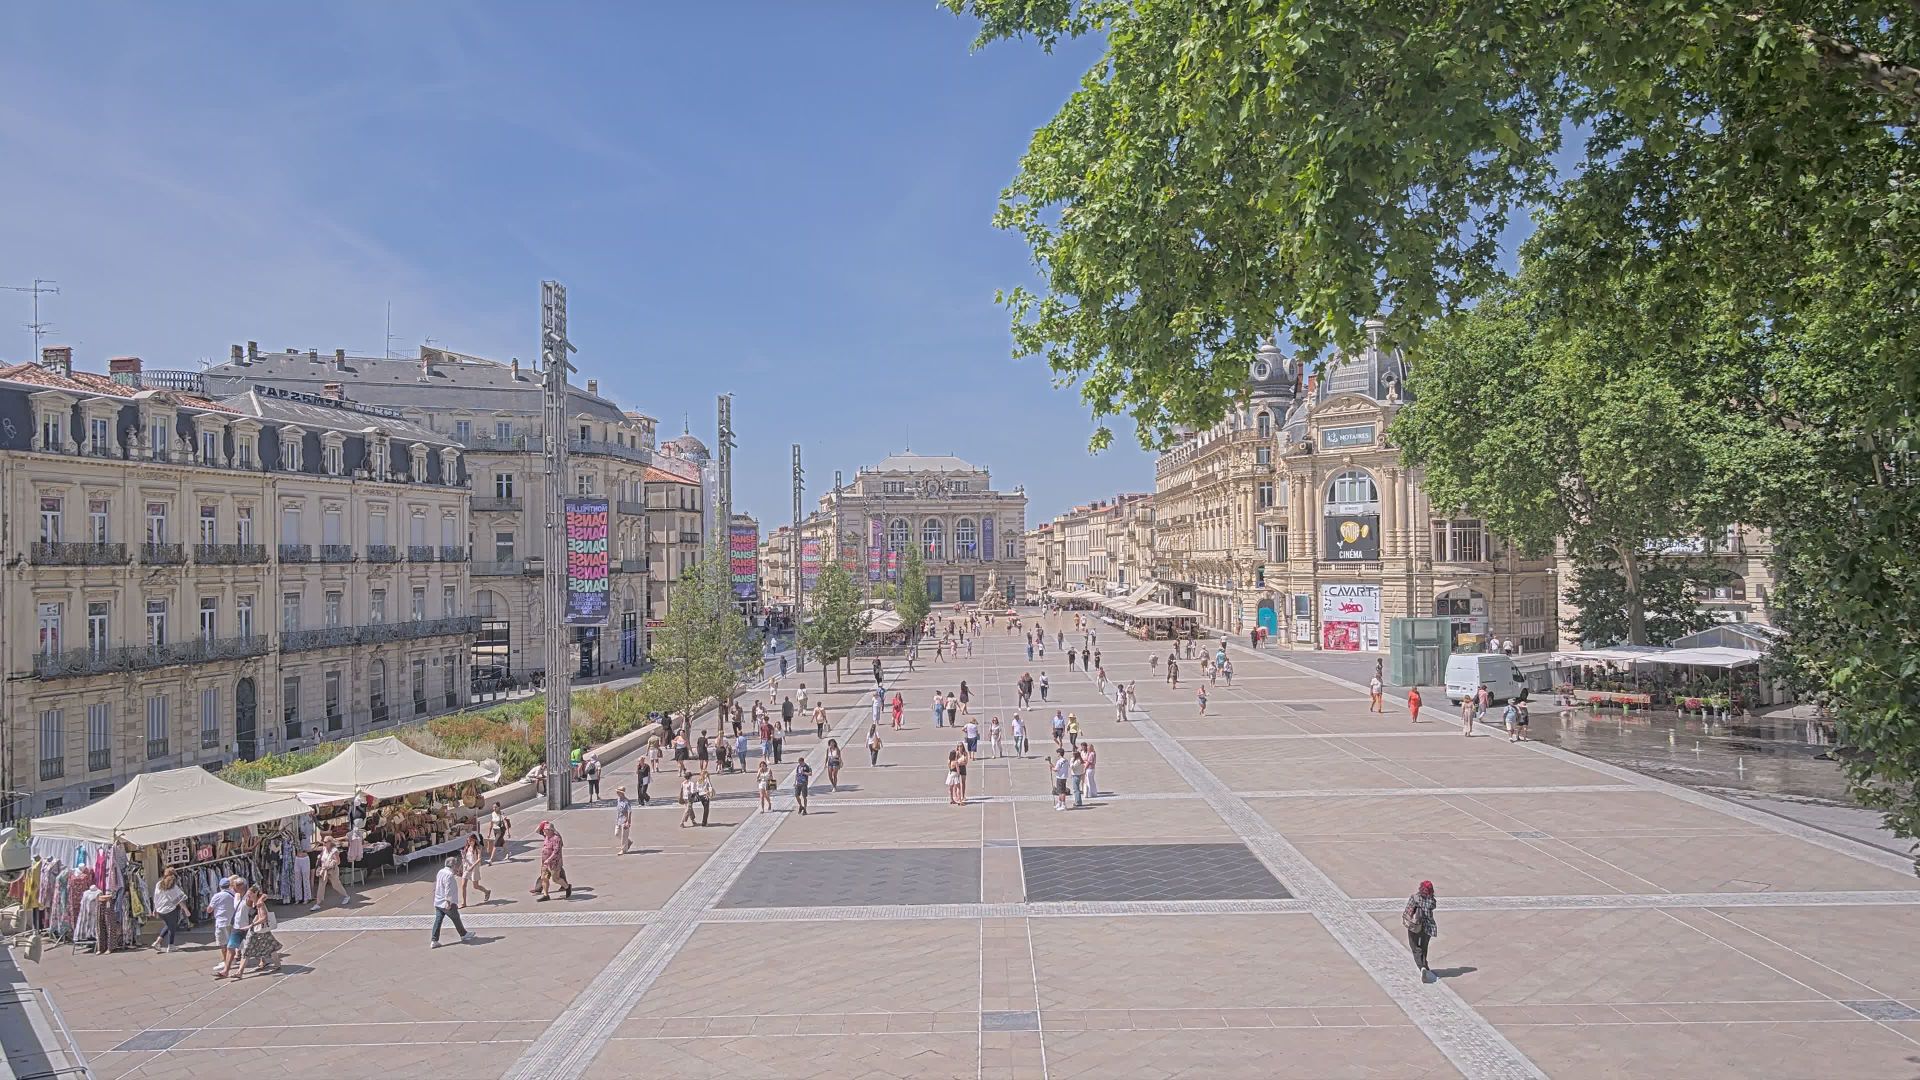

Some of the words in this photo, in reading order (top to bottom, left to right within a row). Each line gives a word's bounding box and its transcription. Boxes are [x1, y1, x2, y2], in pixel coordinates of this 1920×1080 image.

[1340, 432, 1369, 441] NOTAIRES
[731, 535, 756, 543] DANSE
[731, 542, 756, 551] DANSE
[731, 550, 756, 559] DANSE
[1339, 549, 1363, 559] CINÉMA
[731, 558, 756, 567] DANSE
[731, 566, 756, 574] DANSE
[731, 574, 756, 583] DANSE
[1329, 586, 1374, 596] CAVART
